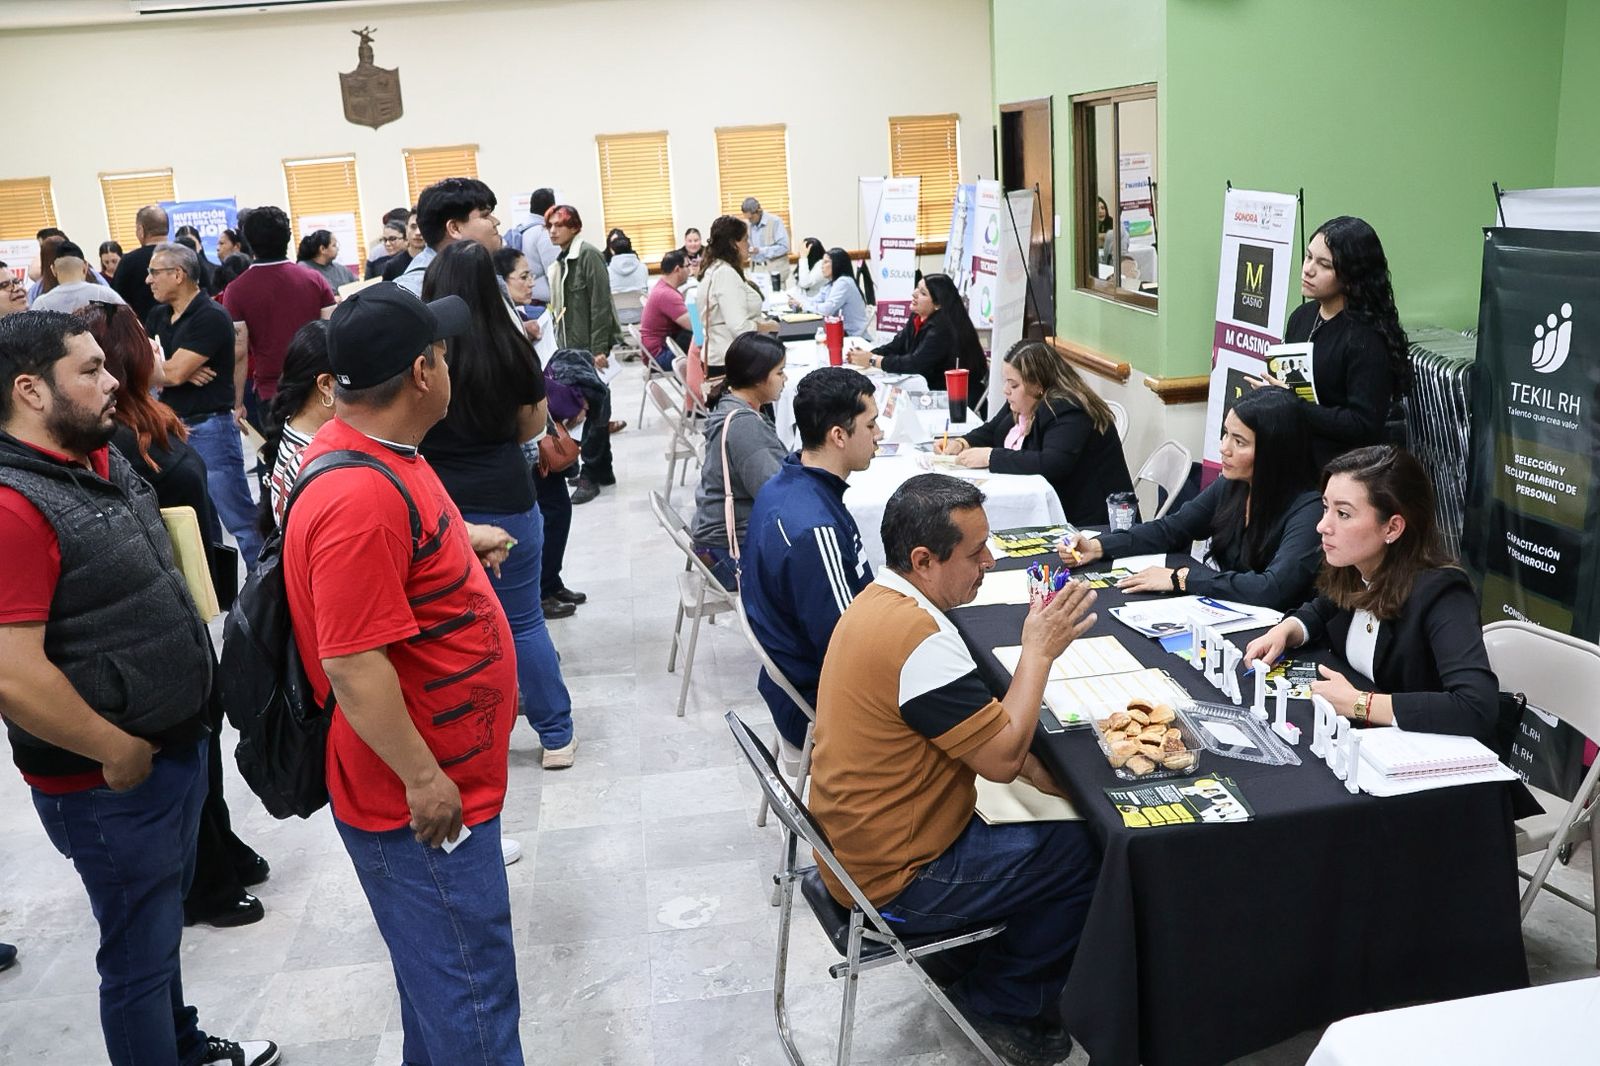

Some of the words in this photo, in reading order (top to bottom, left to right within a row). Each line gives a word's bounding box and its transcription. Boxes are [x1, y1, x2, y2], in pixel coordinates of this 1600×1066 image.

[173, 208, 226, 220] NUTRICIÓN
[1234, 211, 1258, 223] SONORA
[1245, 261, 1265, 294] M
[1241, 295, 1263, 309] CASINO
[1225, 329, 1235, 345] M
[1236, 332, 1271, 355] CASINO
[1511, 382, 1555, 410] TEKIL
[1558, 392, 1581, 416] RH
[1508, 406, 1532, 419] Talento
[1533, 413, 1546, 422] que
[1546, 416, 1561, 426] crea
[1561, 420, 1579, 430] valor
[1514, 454, 1558, 475] SELECCIÓN
[1559, 466, 1566, 476] Y
[1504, 464, 1565, 491] RECLUTAMIENTO
[1565, 484, 1577, 496] DE
[1515, 483, 1557, 504] PERSONAL
[1506, 531, 1560, 561] CAPACITACIÓN
[1507, 545, 1512, 554] Y
[1511, 548, 1556, 574] DESARROLLO
[1309, 693, 1363, 795] RH
[1529, 727, 1541, 743] RH
[1520, 748, 1534, 764] RH
